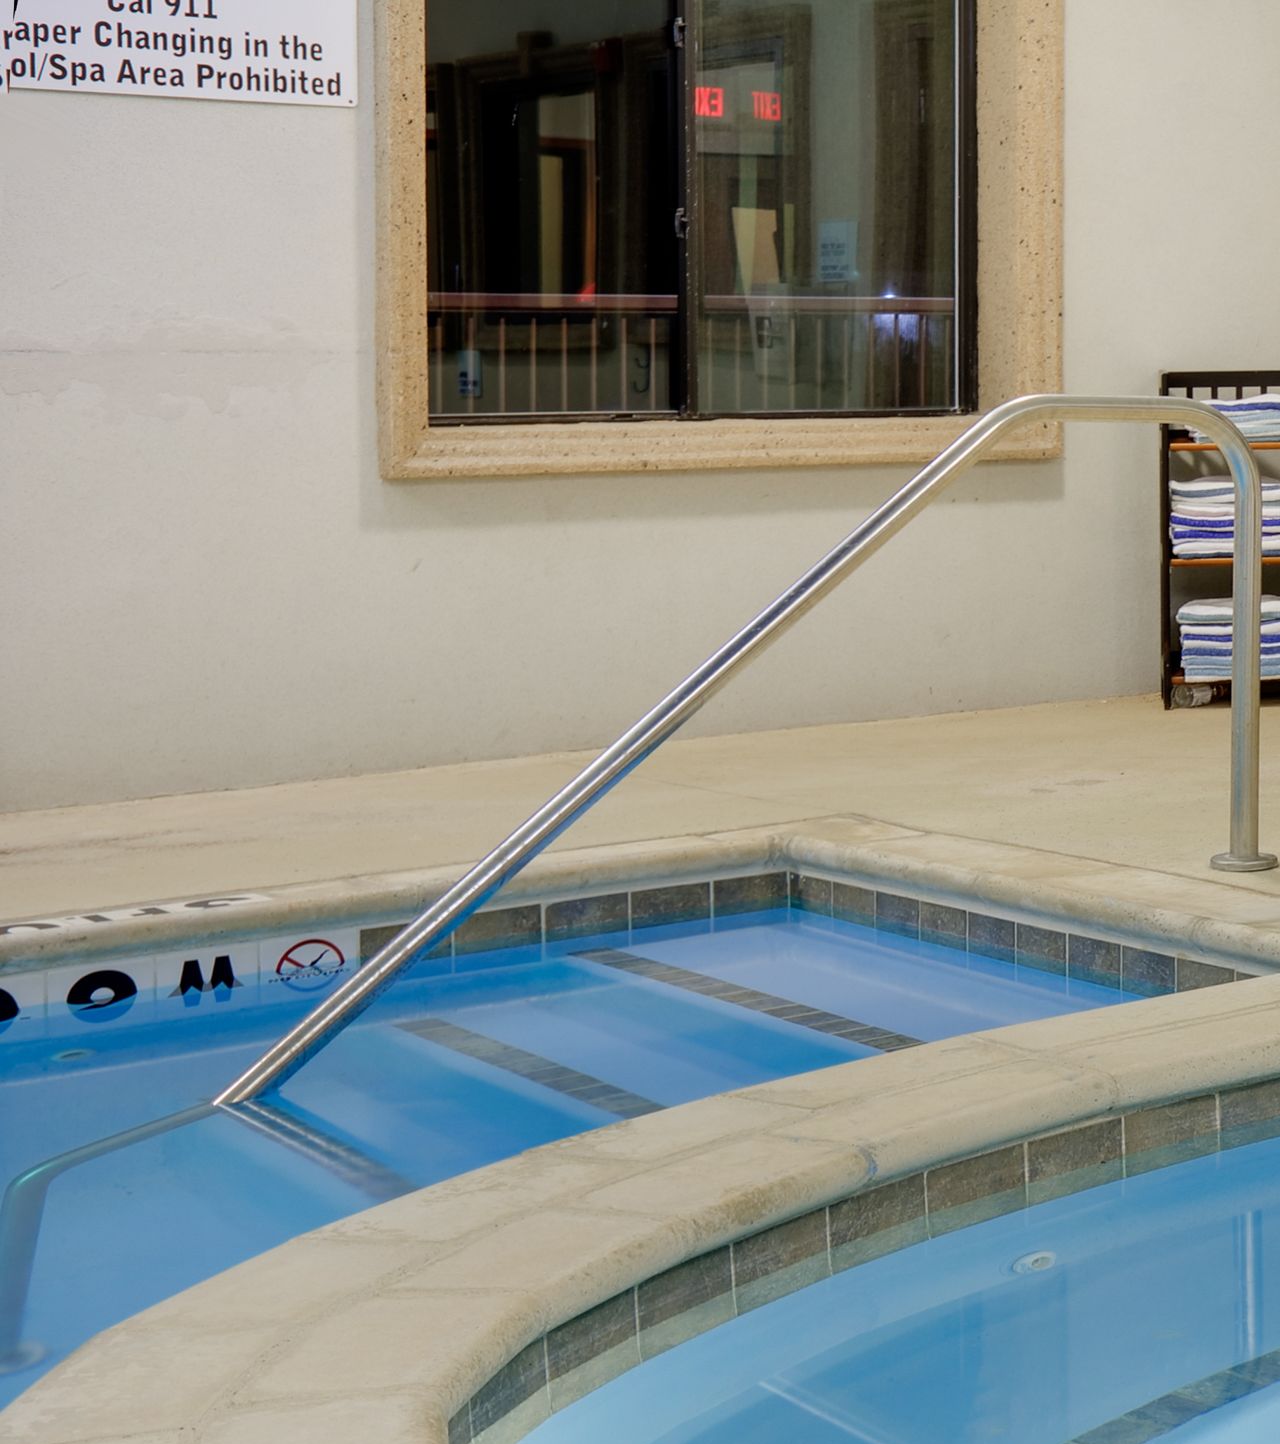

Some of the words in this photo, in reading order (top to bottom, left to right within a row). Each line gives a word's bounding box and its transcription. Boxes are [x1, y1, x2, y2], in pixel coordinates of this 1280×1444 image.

[164, 0, 218, 19] 911
[94, 20, 232, 60] Changing
[244, 31, 269, 57] in
[279, 34, 323, 61] the
[116, 58, 185, 87] Area
[196, 63, 342, 97] Prohibited
